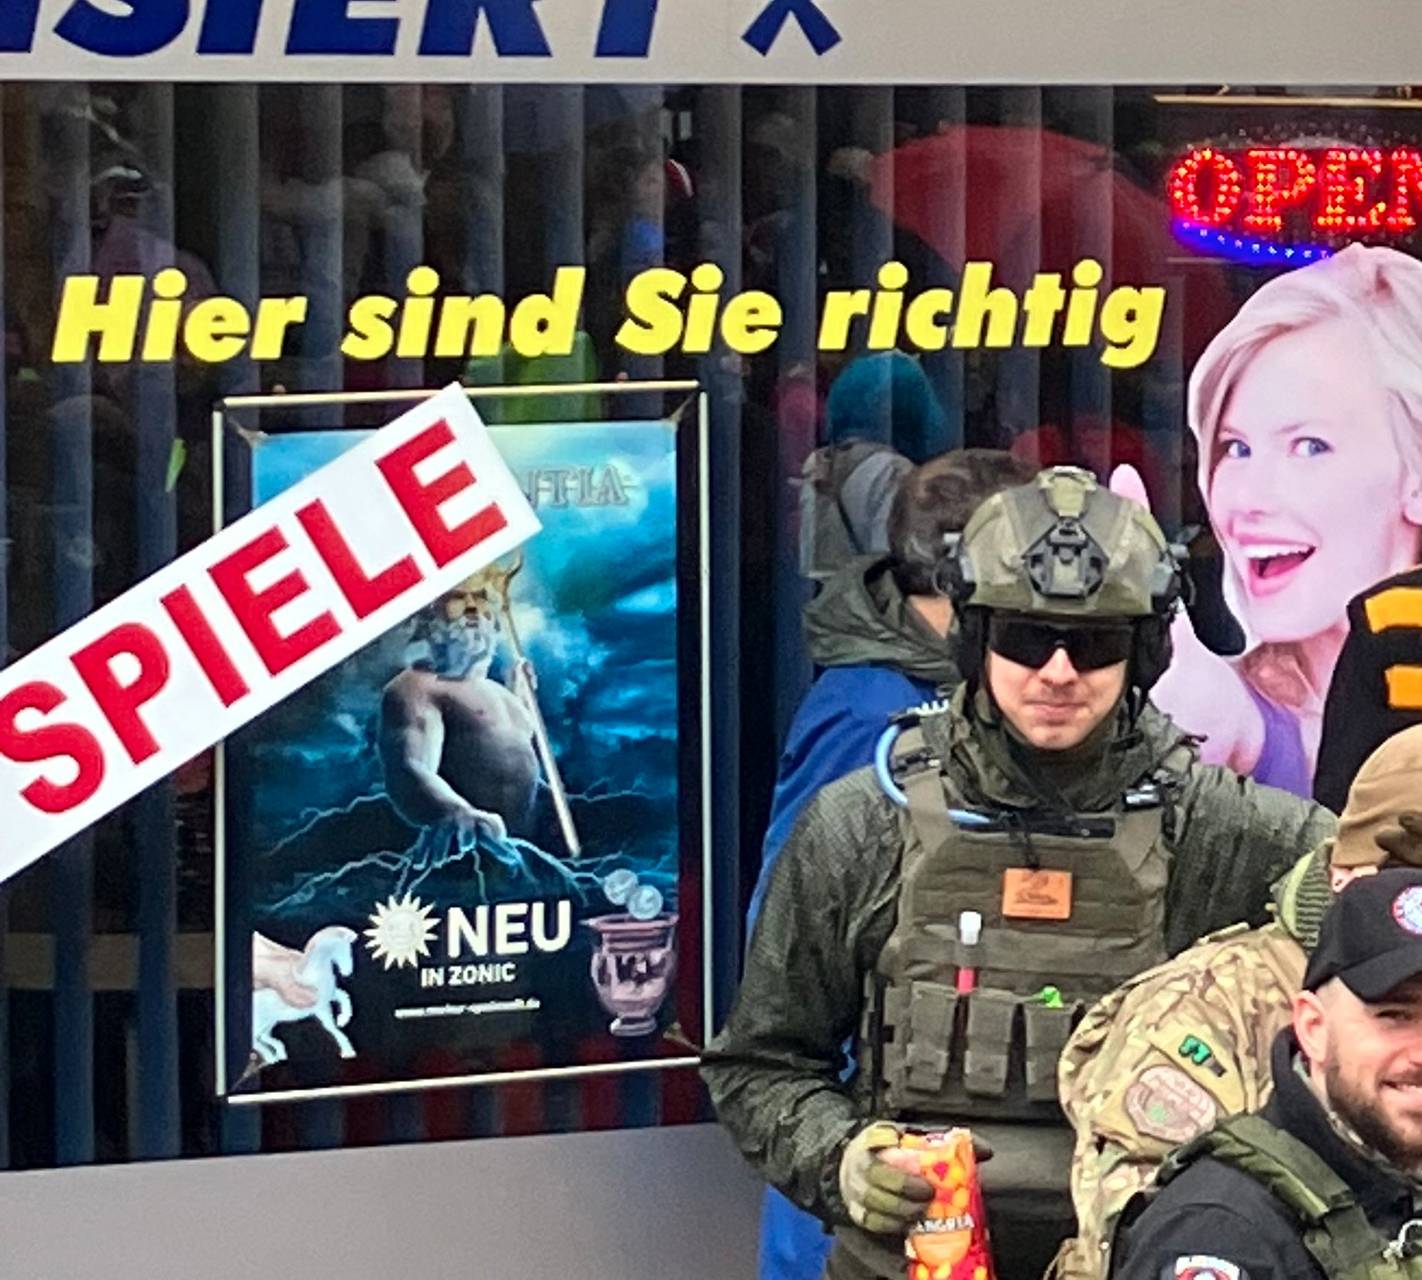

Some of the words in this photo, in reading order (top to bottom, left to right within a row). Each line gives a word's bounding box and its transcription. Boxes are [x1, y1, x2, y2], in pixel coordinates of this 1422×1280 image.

[52, 268, 307, 362] Hier
[341, 266, 585, 359] sind
[615, 263, 782, 354] Sie
[818, 260, 1166, 368] richtig
[0, 417, 508, 814] SPIELE
[447, 900, 571, 959] NEU
[420, 967, 445, 988] IN
[448, 961, 516, 986] ZONIC
